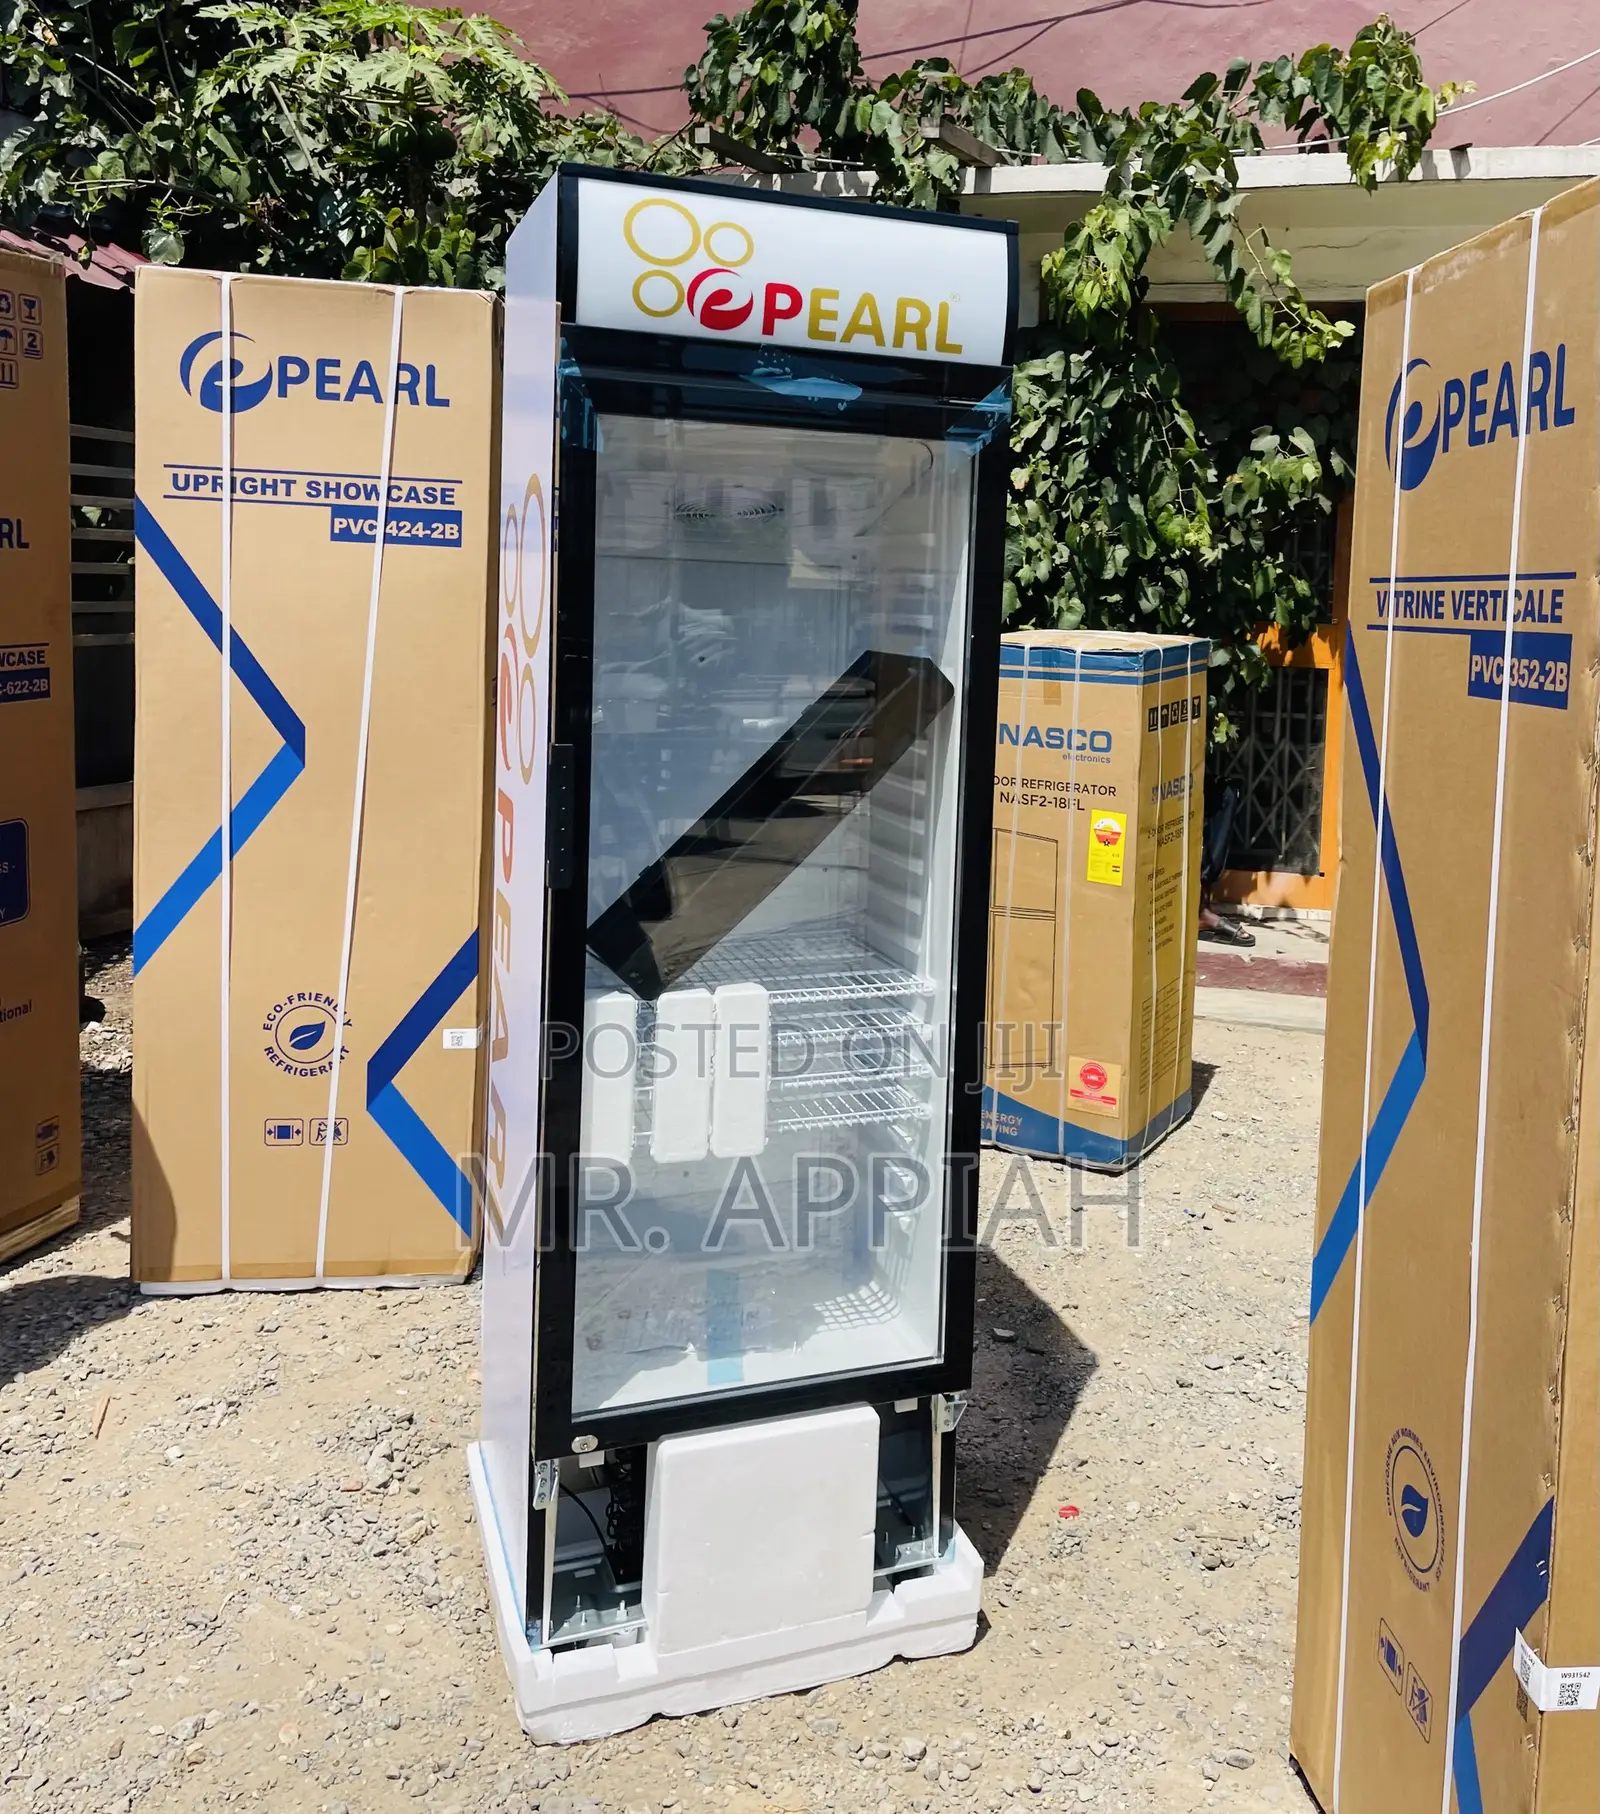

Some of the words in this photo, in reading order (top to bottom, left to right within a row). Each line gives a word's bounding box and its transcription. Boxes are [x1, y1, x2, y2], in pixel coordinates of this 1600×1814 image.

[761, 282, 962, 354] PEARL
[277, 355, 450, 407] PEARL
[1442, 343, 1576, 453] PEARL
[172, 473, 297, 497] UPRIGHT
[305, 480, 456, 505] SHOWCASE
[333, 518, 460, 539] PVC424-2B
[1376, 590, 1446, 620] VITRINE
[1451, 589, 1564, 624] VERTICALE
[0, 678, 49, 696] -622-2B
[1471, 655, 1568, 692] PVC352-2B
[998, 723, 1112, 753] NASCO
[1062, 753, 1111, 764] elctronics
[1021, 778, 1116, 797] REFRIGERATOR
[263, 992, 352, 1031] ECO-FRIENY
[1560, 1671, 1591, 1679] W931542
